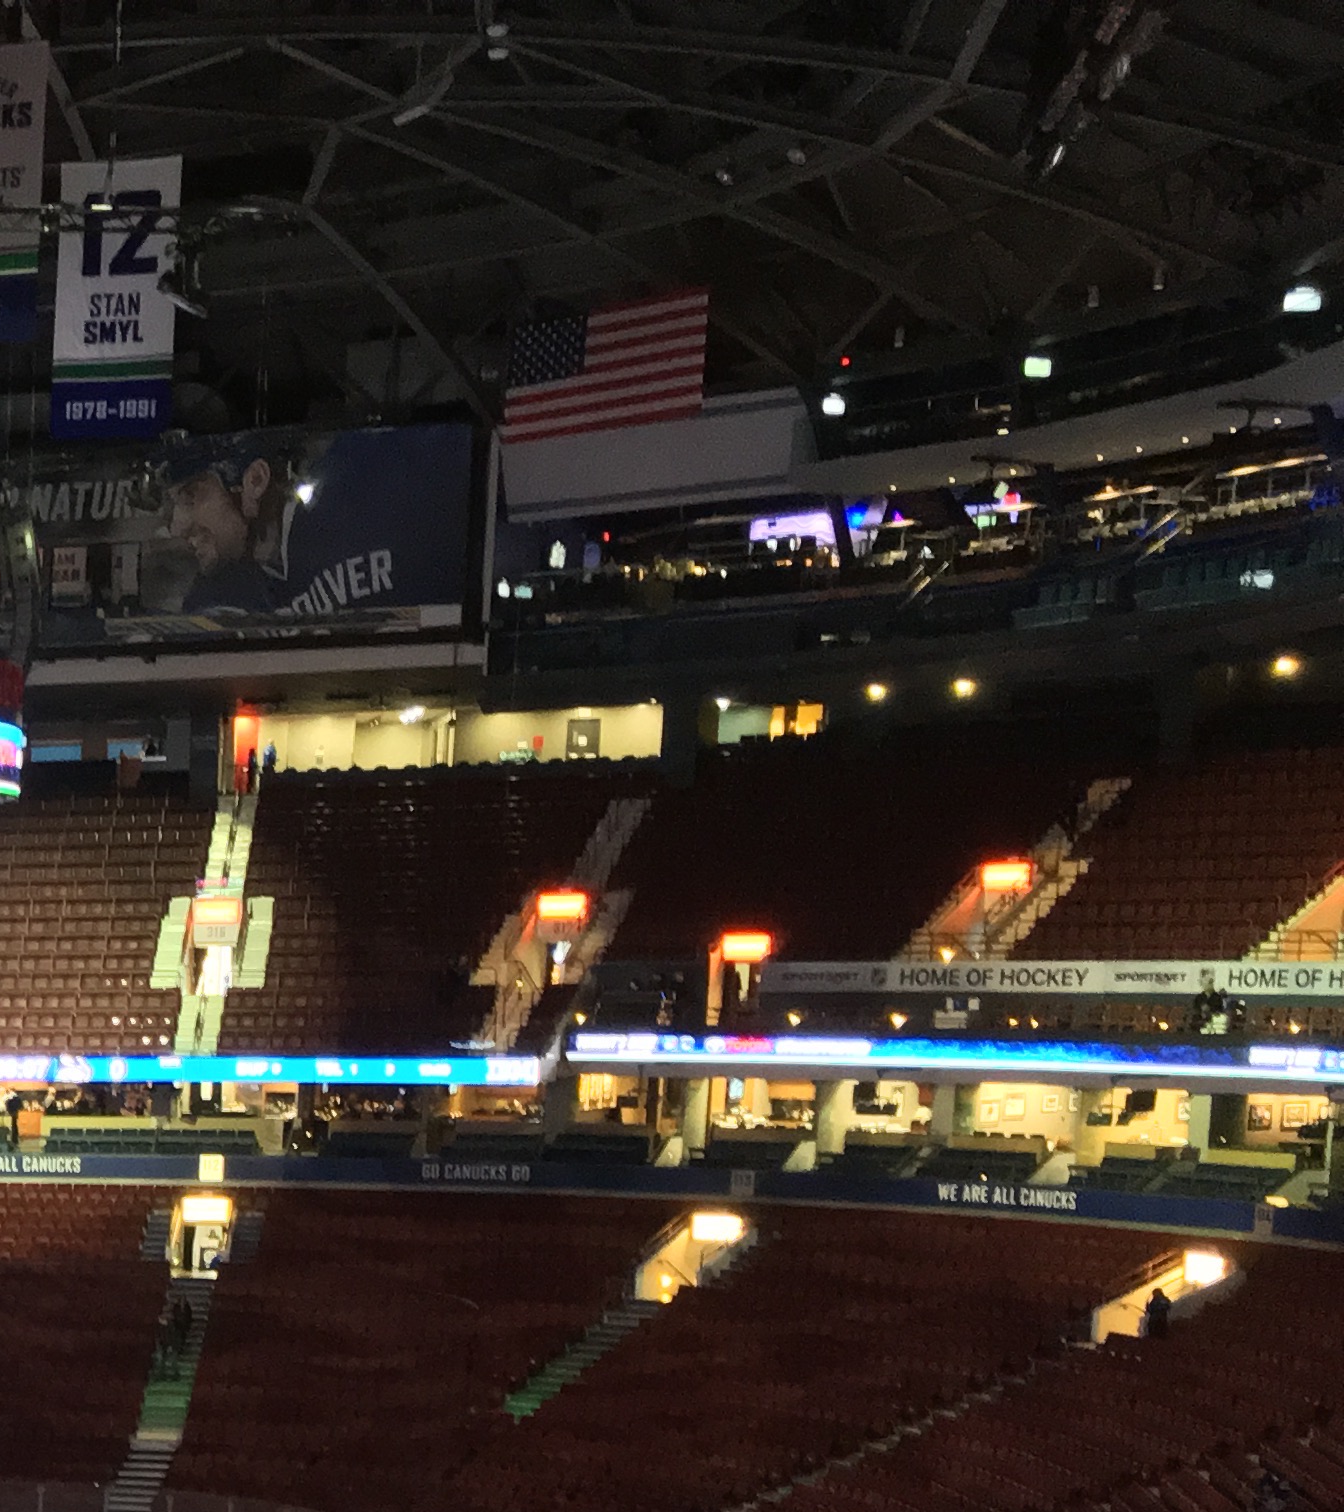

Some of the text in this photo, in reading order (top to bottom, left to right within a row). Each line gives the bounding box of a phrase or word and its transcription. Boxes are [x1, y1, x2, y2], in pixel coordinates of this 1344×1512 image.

[81, 189, 162, 276] 12
[88, 292, 141, 318] STAN
[83, 319, 144, 345] SMYL
[64, 399, 158, 422] 1978-1991
[30, 479, 136, 525] NATUR
[899, 968, 958, 987] HOME
[964, 968, 994, 987] OF
[999, 968, 1091, 988] HOCKEY
[1227, 968, 1287, 988] HOME
[1291, 968, 1321, 988] OF
[23, 1156, 82, 1174] CANUCKS
[421, 1162, 531, 1184] GO CANUCKS GO
[937, 1182, 1078, 1211] WE ARE ALL CANUCKS
